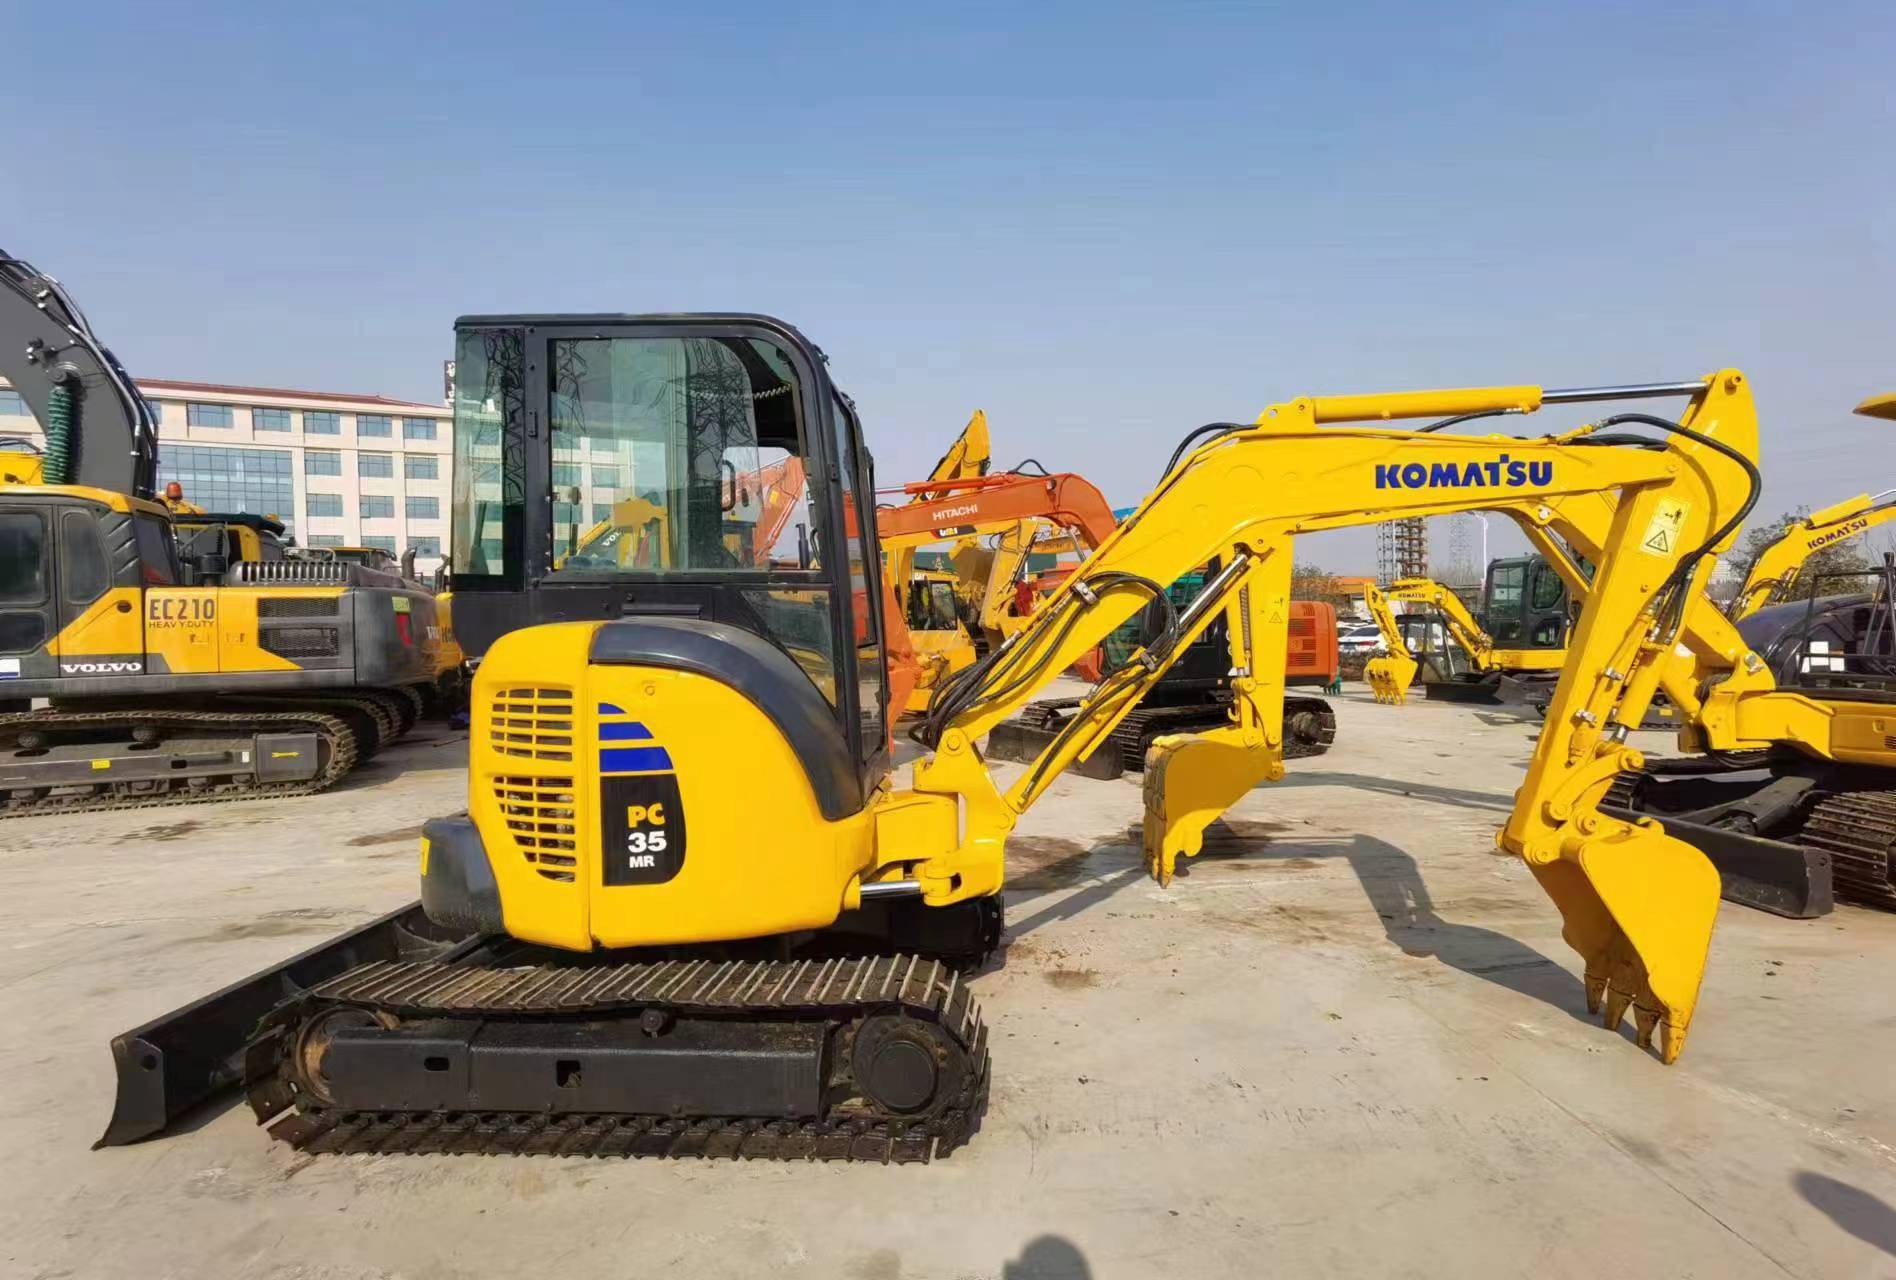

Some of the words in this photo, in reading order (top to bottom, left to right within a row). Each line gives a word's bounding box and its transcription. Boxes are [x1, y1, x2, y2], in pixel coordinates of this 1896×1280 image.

[1375, 453, 1553, 489] KOMATSU
[932, 503, 979, 521] HITACHI
[1807, 518, 1868, 550] KOMATSU
[149, 598, 216, 620] EC210
[60, 662, 143, 674] VOLVO
[627, 802, 666, 828] PC
[627, 830, 668, 853] 35
[629, 855, 656, 869] MR
